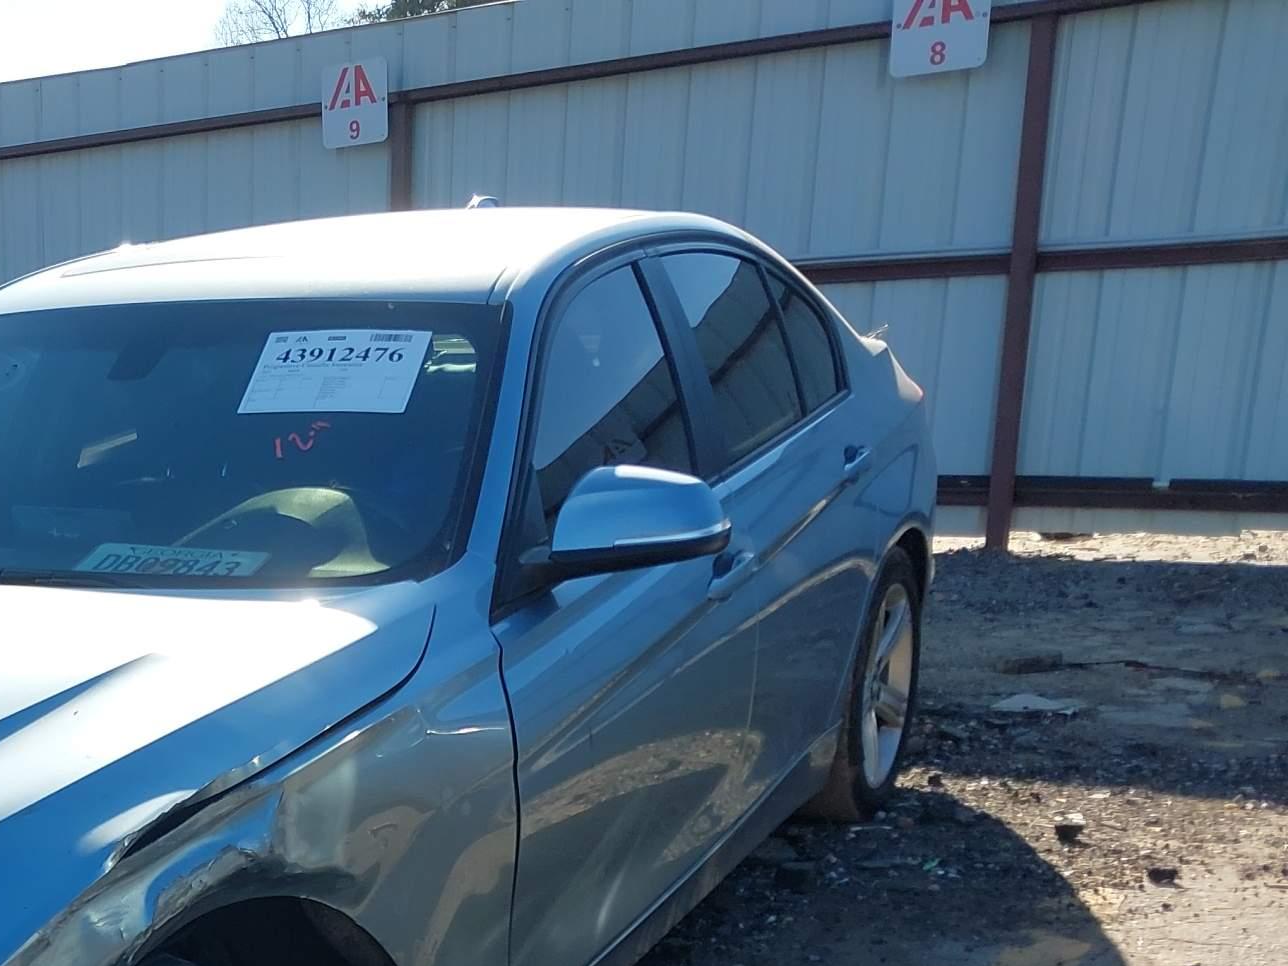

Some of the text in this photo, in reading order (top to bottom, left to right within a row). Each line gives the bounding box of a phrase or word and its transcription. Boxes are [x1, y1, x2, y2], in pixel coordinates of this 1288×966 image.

[929, 41, 946, 65] 8
[349, 119, 361, 140] 9
[275, 346, 404, 364] 43912476
